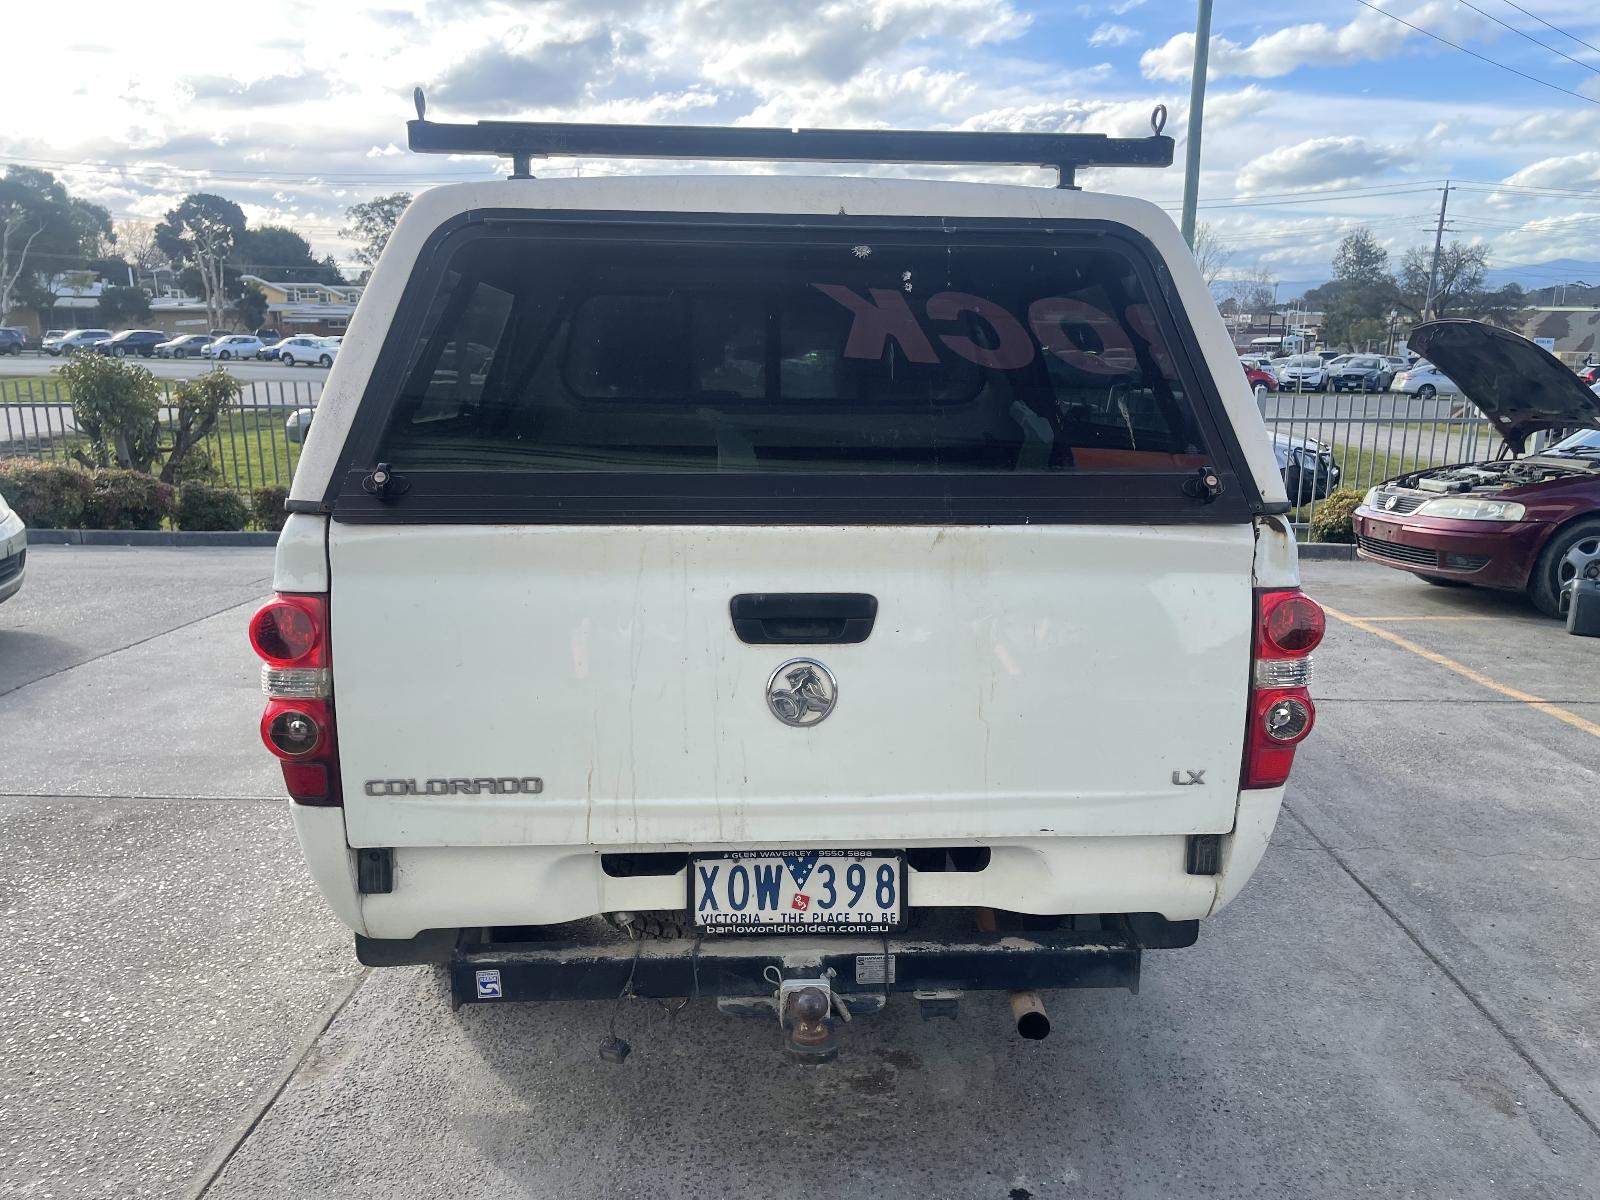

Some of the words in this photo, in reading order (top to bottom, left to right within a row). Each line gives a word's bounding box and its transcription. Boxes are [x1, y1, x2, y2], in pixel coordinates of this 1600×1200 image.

[1171, 769, 1206, 786] LX
[364, 777, 544, 796] COLORADO
[731, 851, 757, 859] GLEN
[759, 850, 812, 858] WAVERLEY
[698, 864, 784, 912] XOW
[816, 863, 896, 910] 398
[701, 913, 761, 924] VICTORIA
[780, 912, 805, 924] THE
[812, 912, 850, 923] PLACE
[857, 912, 874, 923] TO
[881, 912, 896, 923] BE
[706, 924, 889, 934] barloworldholden.com.au
